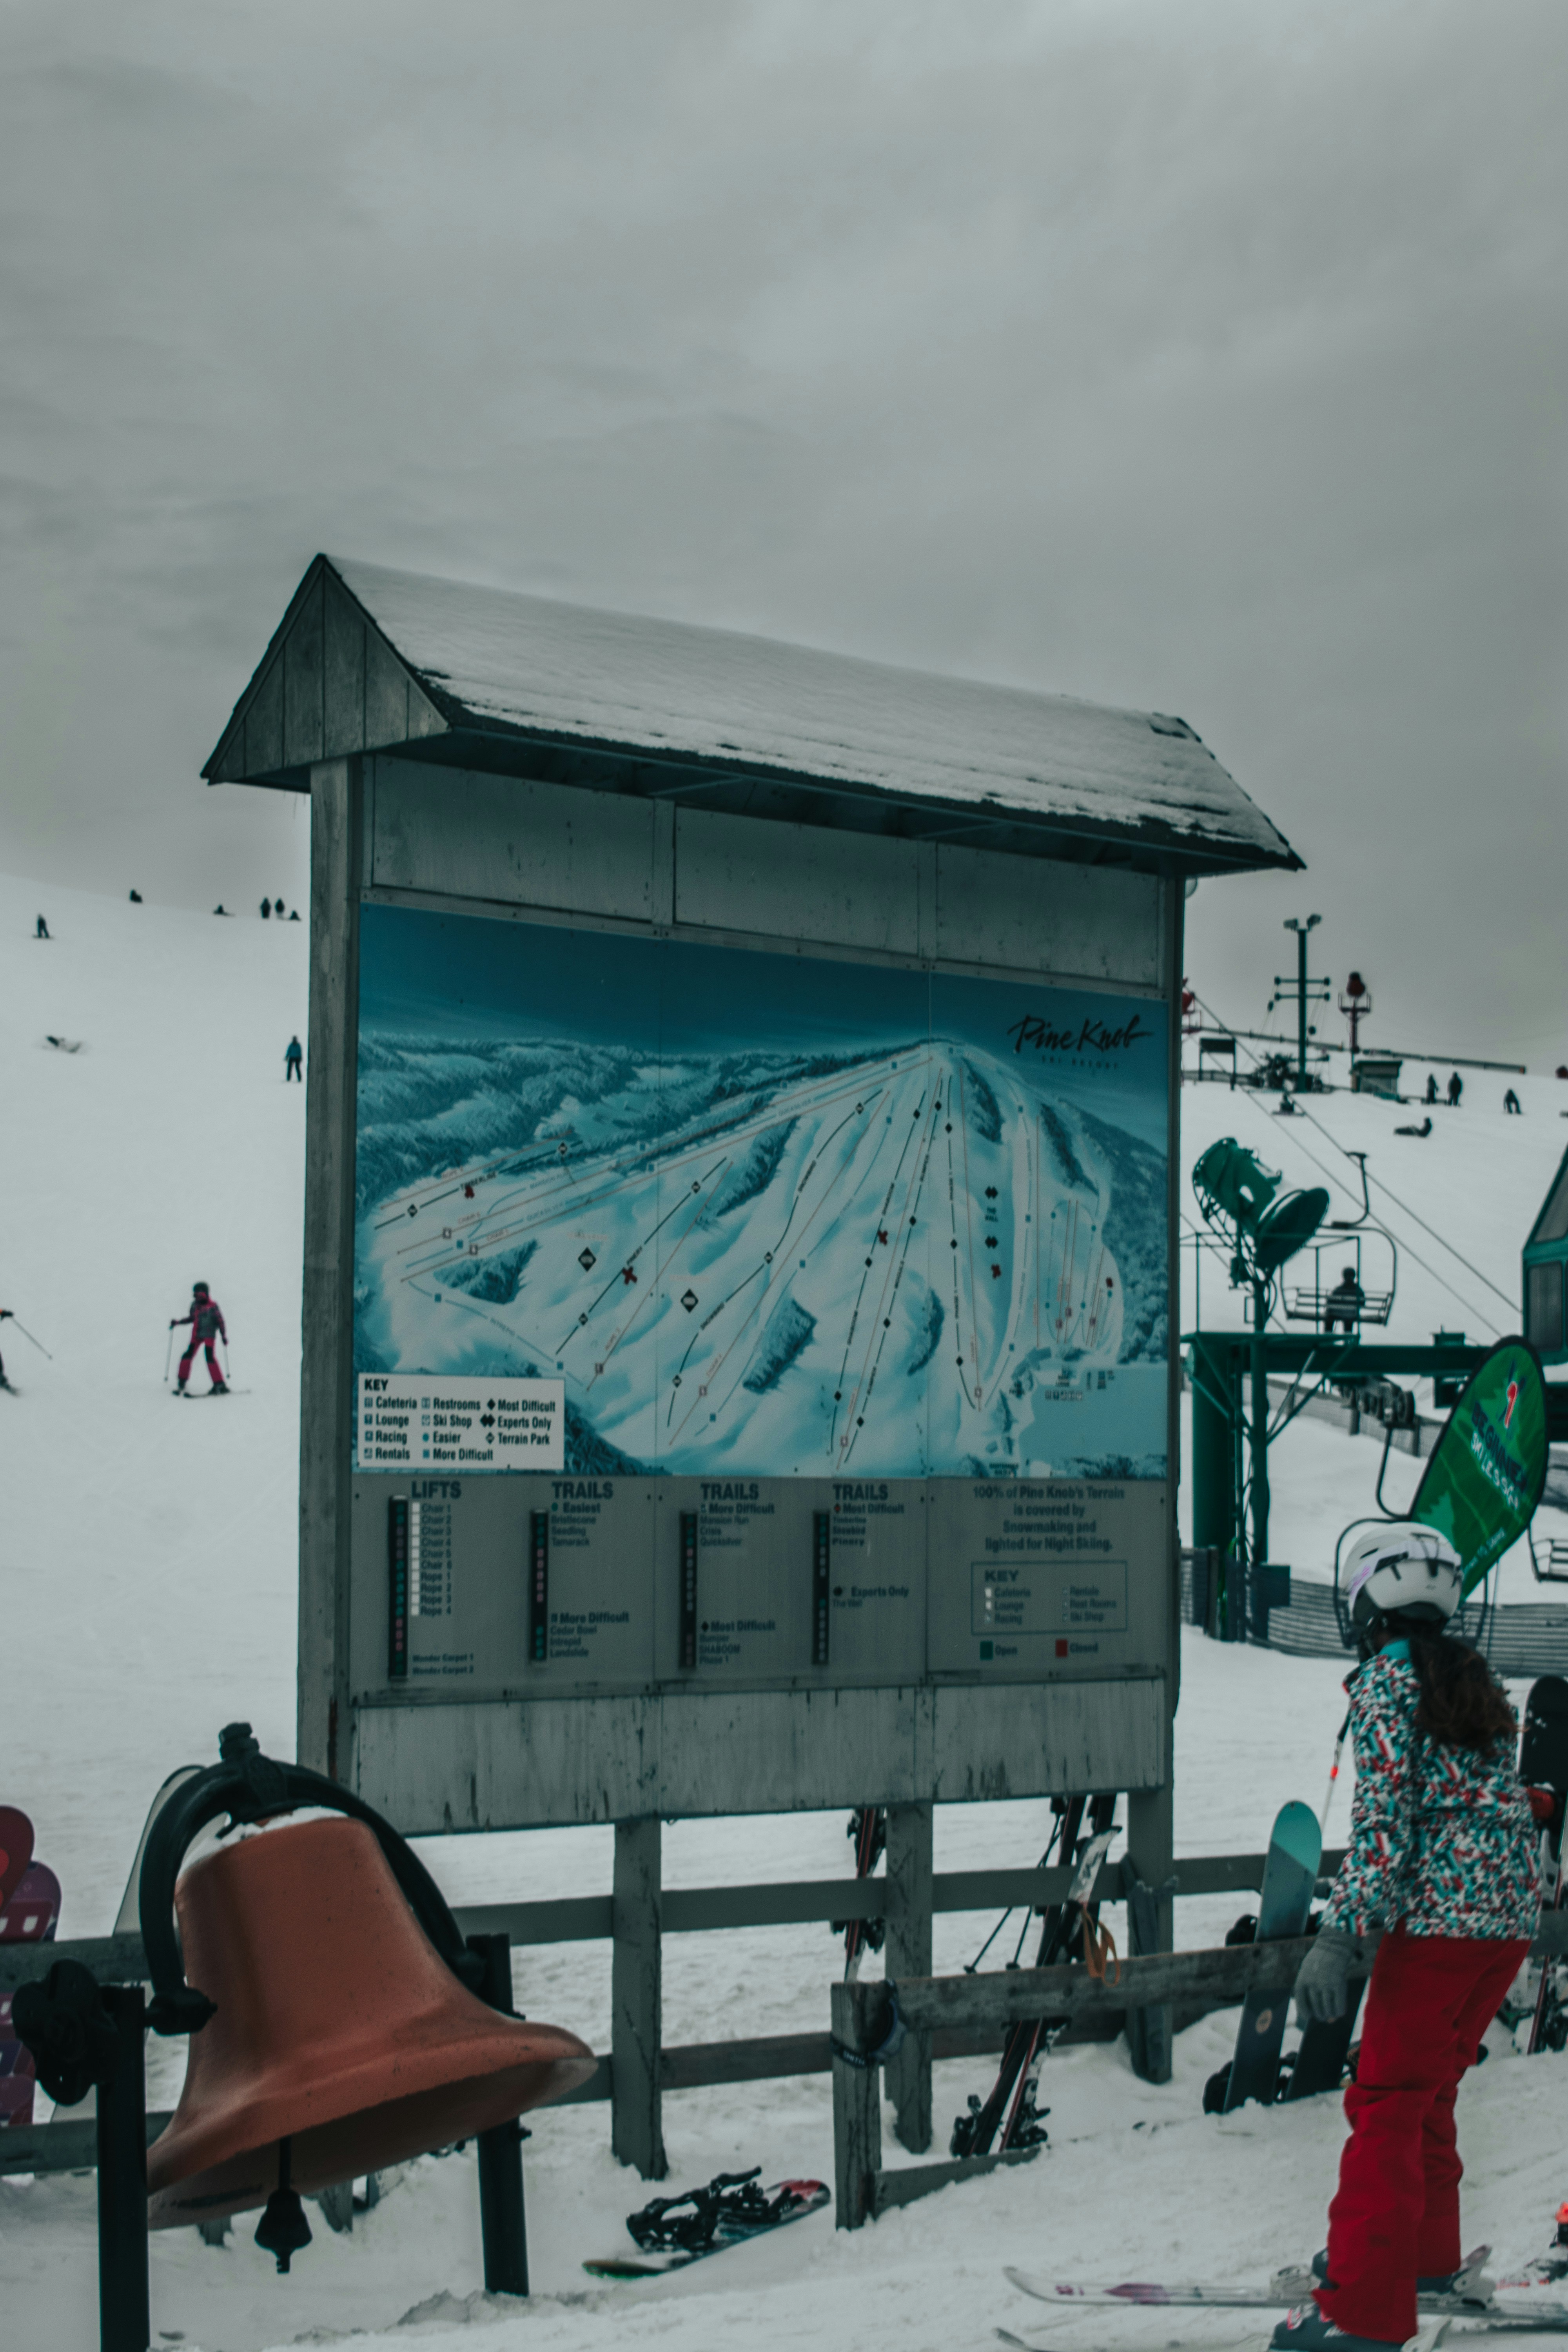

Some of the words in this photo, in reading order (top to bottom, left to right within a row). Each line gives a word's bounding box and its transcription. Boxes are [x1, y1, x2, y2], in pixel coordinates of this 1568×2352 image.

[1007, 1014, 1077, 1053] Pine
[1075, 1014, 1154, 1053] Knob
[365, 1379, 388, 1391] KEY
[376, 1396, 417, 1409] Cafeteria
[434, 1397, 481, 1410] Restrooms
[498, 1399, 519, 1411] Most
[522, 1399, 555, 1412] Difficult
[376, 1414, 409, 1428] Lounge
[434, 1414, 447, 1426] Ski
[450, 1415, 472, 1429] Shop
[498, 1416, 530, 1430] Experts
[533, 1416, 552, 1430] Only
[376, 1430, 407, 1445] Racing
[434, 1432, 461, 1443] Easier
[498, 1432, 528, 1445] Terrain
[531, 1433, 550, 1445] Park
[376, 1447, 410, 1460] Rentals
[434, 1448, 456, 1461] More
[459, 1448, 494, 1461] Difficult
[412, 1480, 462, 1499] LIFTS
[551, 1481, 613, 1499] TRAILS
[700, 1483, 759, 1501] TRAILS
[833, 1483, 889, 1501] TRAILS
[973, 1485, 1004, 1499] 100%
[1006, 1485, 1017, 1499] of
[1020, 1485, 1044, 1499] Pine
[1046, 1486, 1083, 1499] Knob's
[1086, 1486, 1125, 1499] Terrain
[563, 1502, 601, 1513] Easiest
[709, 1503, 734, 1514] More
[736, 1503, 775, 1514] Difficult
[843, 1503, 866, 1514] Most
[867, 1503, 904, 1514] Difficult
[1025, 1503, 1070, 1516] covered
[1072, 1503, 1085, 1518] by
[446, 1515, 451, 1524] 2
[1003, 1519, 1074, 1535] Snowmaking
[1076, 1520, 1096, 1532] and
[446, 1537, 451, 1546] 4
[832, 1537, 865, 1547] Pinery
[985, 1537, 1024, 1553] lighted
[1027, 1537, 1042, 1550] for
[1045, 1537, 1074, 1553] Night
[421, 1572, 442, 1583] Rope
[984, 1570, 1019, 1582] KEY
[421, 1583, 442, 1593] Rope
[851, 1585, 887, 1599] Experts
[888, 1584, 909, 1599] Only
[994, 1586, 1031, 1597] Cafeteria
[421, 1594, 442, 1605] Rope
[421, 1606, 442, 1618] Rope
[446, 1606, 451, 1615] 4
[994, 1601, 1024, 1612] Lounge
[560, 1613, 586, 1624] More
[588, 1612, 629, 1623] Difficult
[995, 1613, 1022, 1625] Racing
[1084, 1611, 1104, 1623] Shop
[711, 1620, 735, 1632] Most
[737, 1619, 776, 1632] Difficult
[995, 1644, 1018, 1657] Open
[1069, 1641, 1099, 1653] Closed
[443, 1653, 467, 1663] Carpet
[443, 1665, 467, 1676] Carpet
